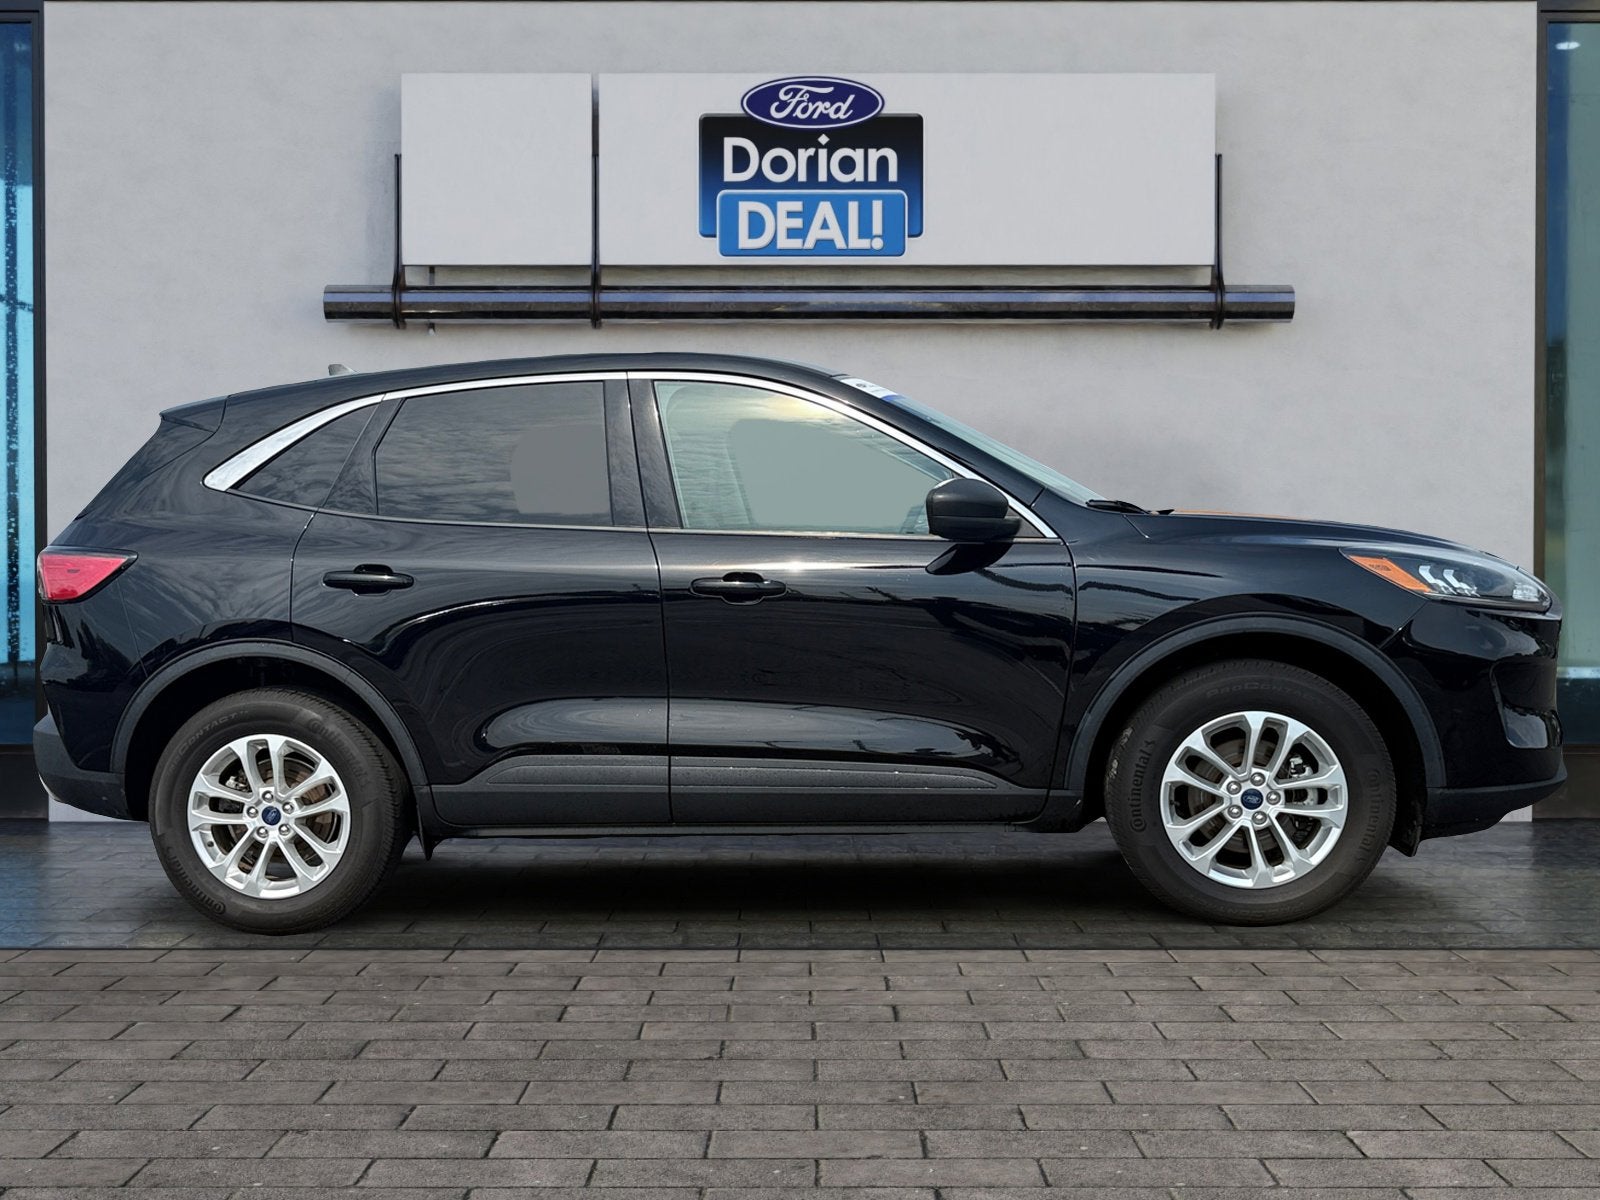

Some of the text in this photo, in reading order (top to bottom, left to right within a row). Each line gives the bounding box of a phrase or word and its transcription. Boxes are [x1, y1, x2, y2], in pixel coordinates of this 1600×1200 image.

[769, 84, 856, 120] Ford
[723, 133, 898, 183] Dorian
[738, 199, 884, 251] DEAL!
[1128, 749, 1152, 832] Continental
